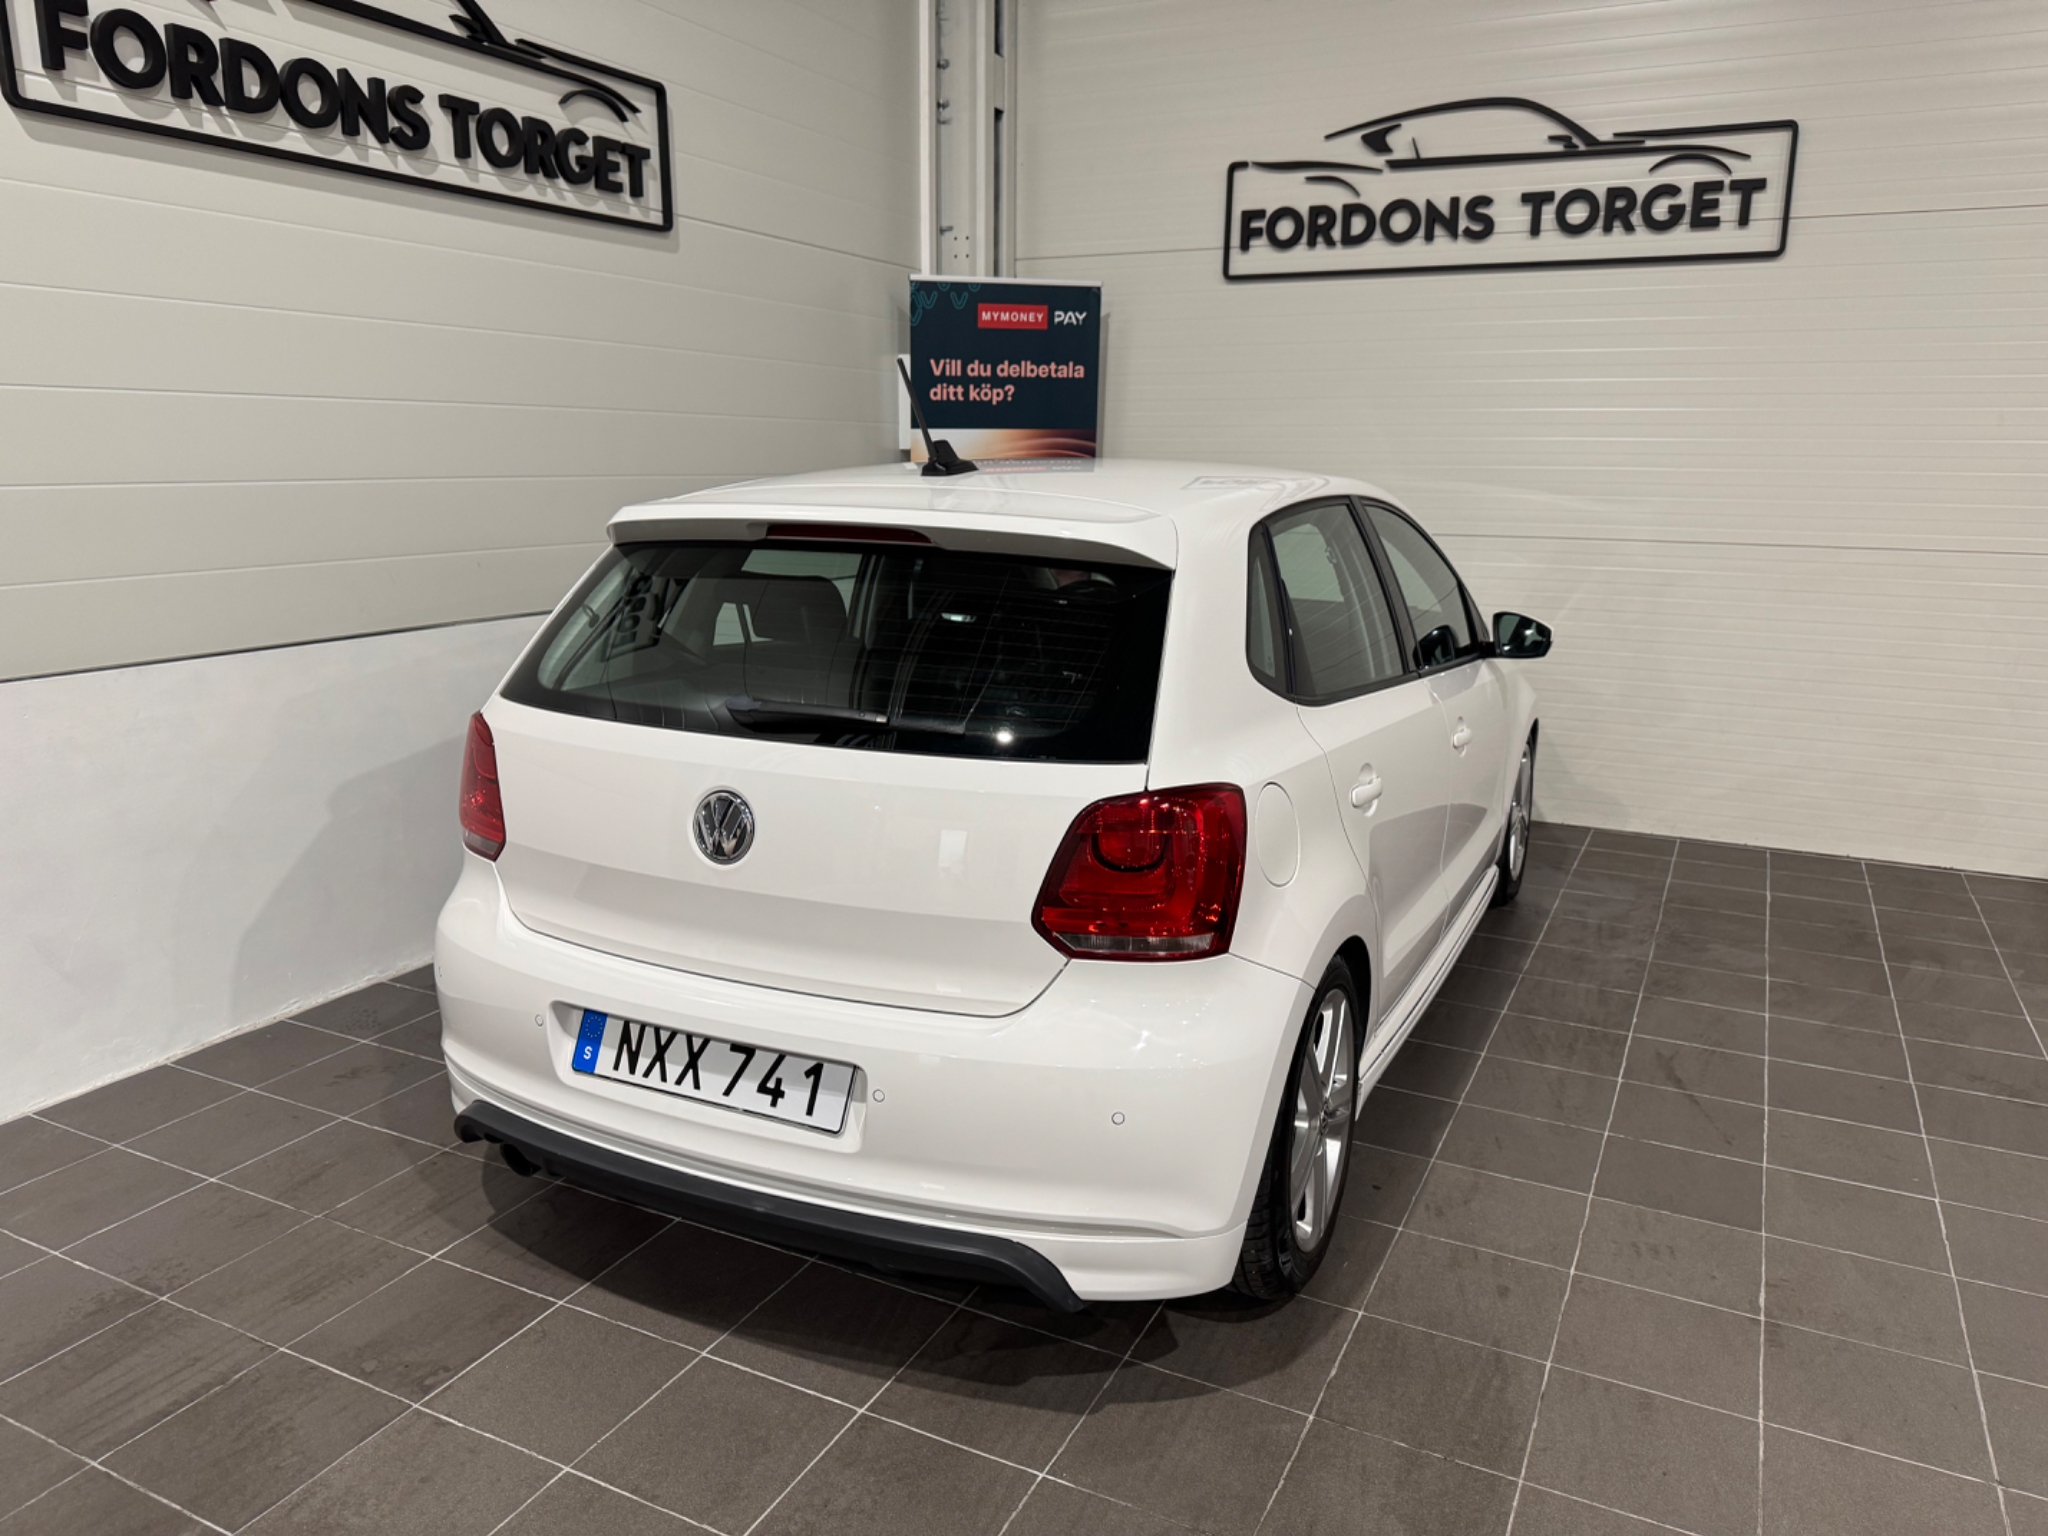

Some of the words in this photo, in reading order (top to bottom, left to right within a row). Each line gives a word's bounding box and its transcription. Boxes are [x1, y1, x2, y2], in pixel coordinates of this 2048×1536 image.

[41, 0, 430, 150] FORDONS
[438, 94, 651, 198] TORGET
[1239, 195, 1495, 252] FORDONS
[1521, 177, 1768, 237] TORGET
[981, 310, 1044, 322] MYMONEY
[1054, 311, 1087, 326] PAY
[930, 359, 962, 377] Vill
[967, 360, 992, 377] du
[996, 361, 1085, 379] delbetala
[929, 383, 964, 401] ditt
[969, 384, 1015, 405] köp?
[583, 1046, 594, 1060] S
[613, 1020, 711, 1091] NXX
[722, 1043, 824, 1117] 741
